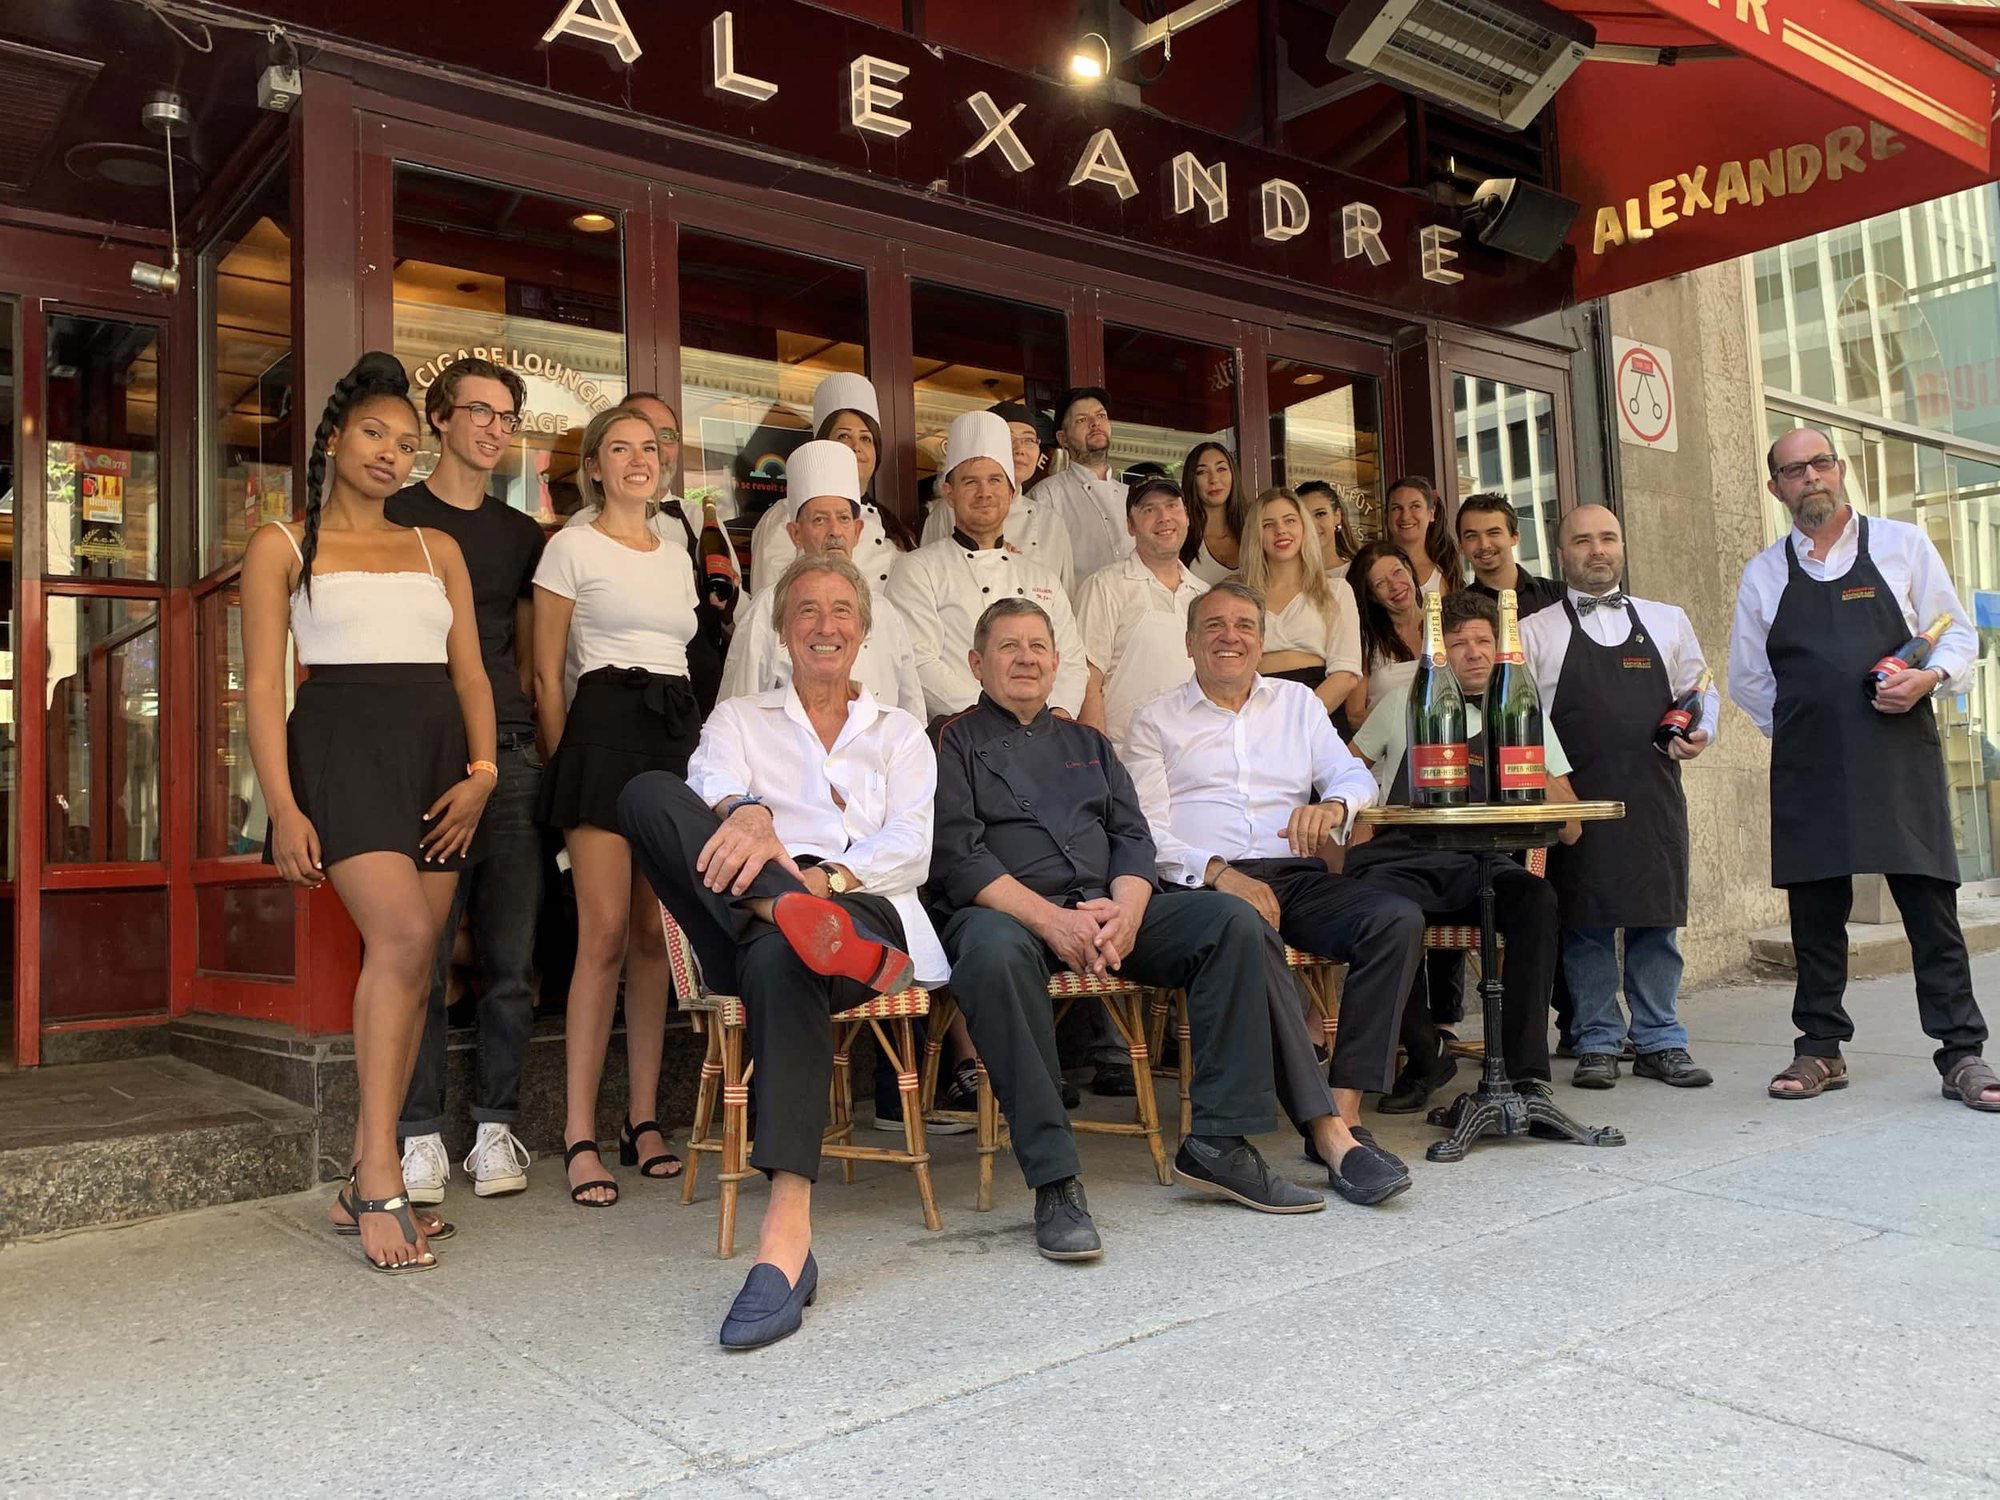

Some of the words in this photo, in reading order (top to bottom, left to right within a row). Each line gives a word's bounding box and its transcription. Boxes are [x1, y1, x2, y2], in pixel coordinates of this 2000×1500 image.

[541, 0, 1464, 285] ALEXANDRE
[1593, 119, 1906, 254] ALEXANDRE
[414, 347, 505, 389] CIGARE
[512, 349, 613, 416] LOUNGE
[519, 409, 568, 436] AGE
